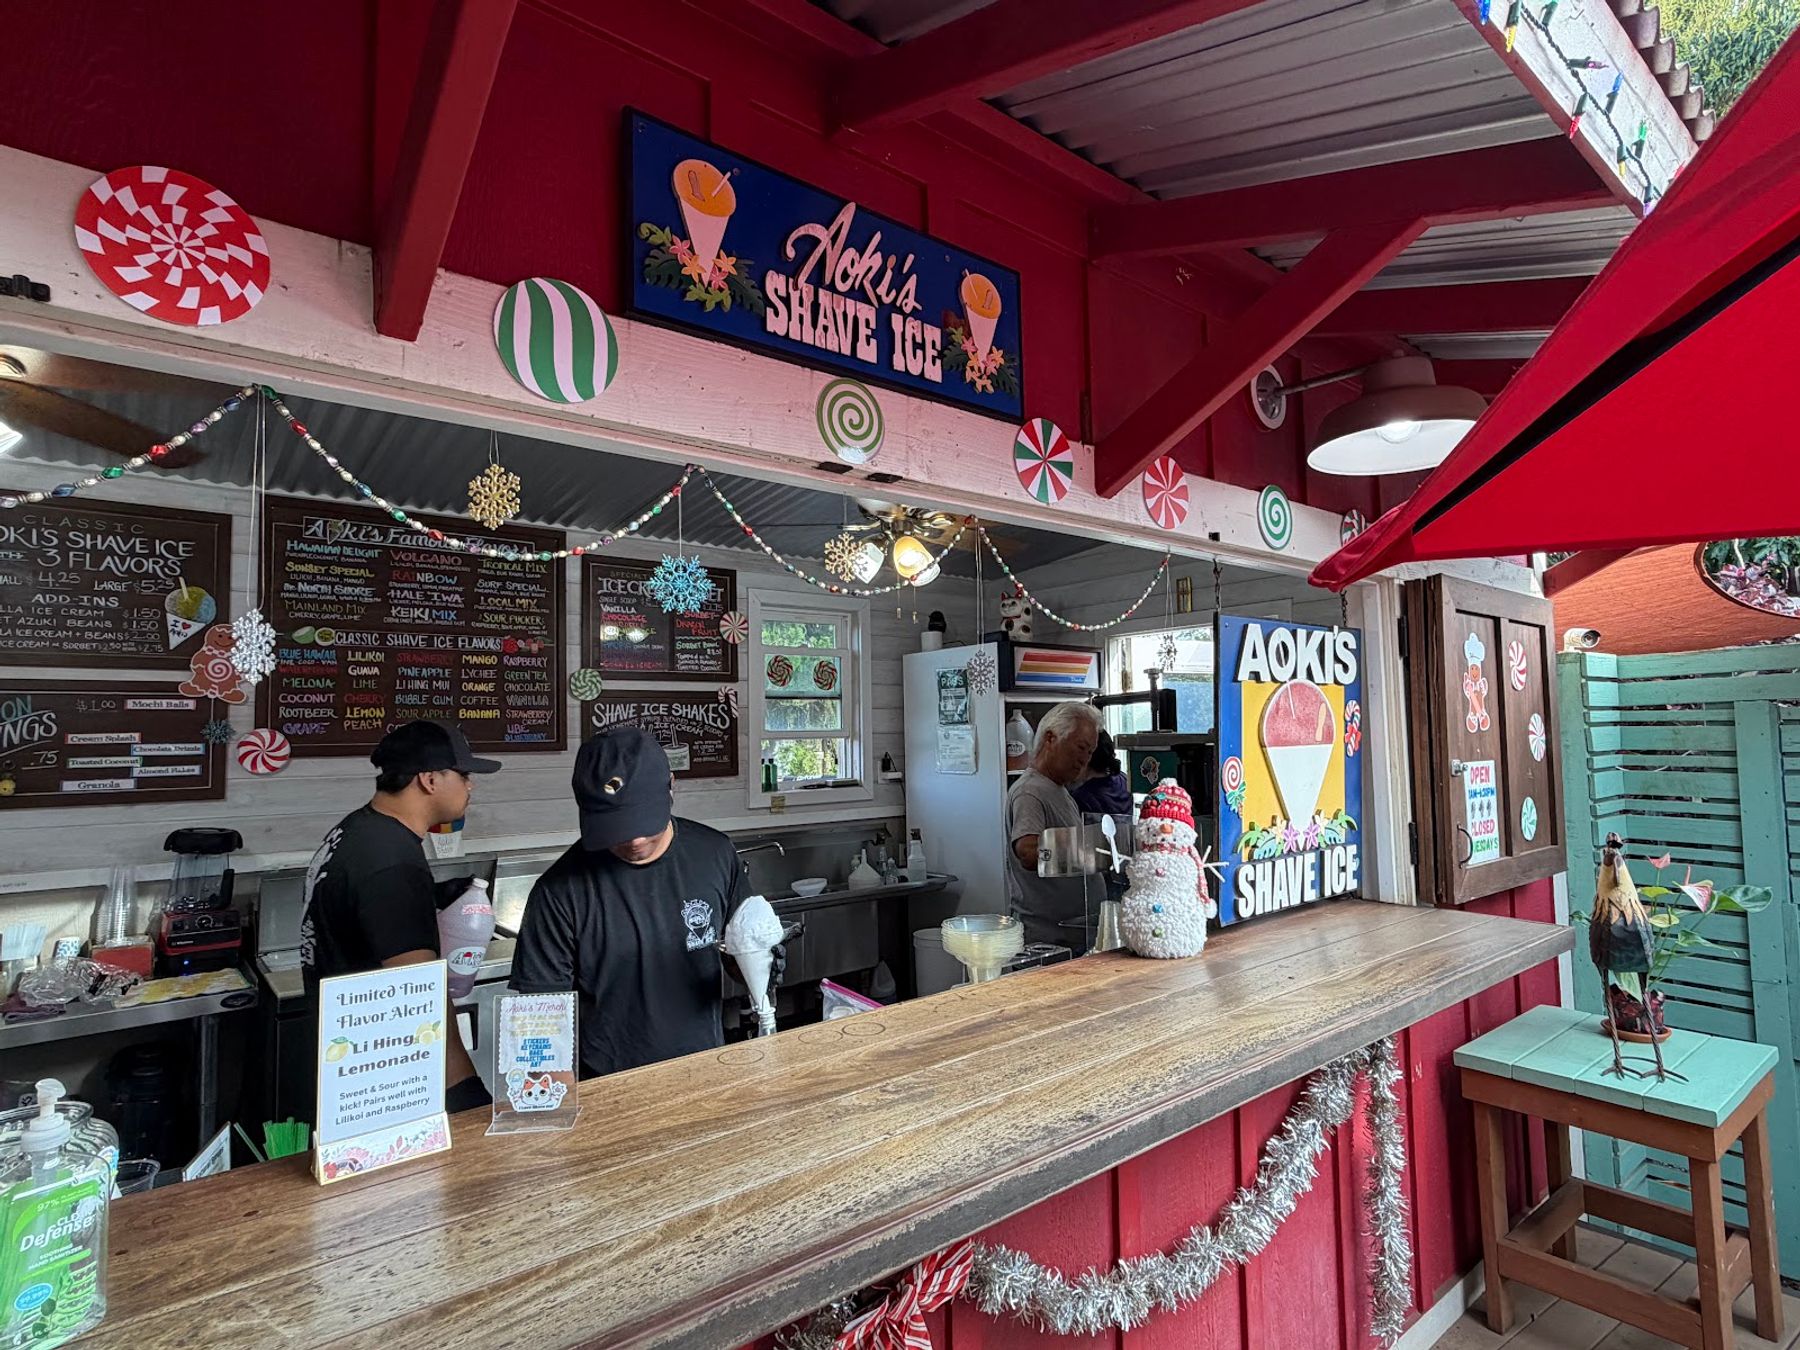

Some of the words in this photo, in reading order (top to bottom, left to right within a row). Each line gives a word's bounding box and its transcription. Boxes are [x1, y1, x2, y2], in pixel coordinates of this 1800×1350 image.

[785, 202, 923, 314] Aoki's
[765, 269, 877, 365] SHAVE
[892, 314, 942, 384] ICE
[23, 515, 145, 535] CLASSIC
[66, 531, 149, 556] SHAVE
[156, 540, 196, 559] ICE
[37, 548, 61, 567] 3
[69, 551, 182, 579] FLAVORS
[390, 549, 463, 566] VOLCANO
[329, 565, 375, 578] SPECIAL
[392, 569, 458, 584] RAINBOW
[94, 580, 131, 593] LARGE
[506, 581, 547, 592] SPECIAL
[31, 593, 119, 607] ADD-INS
[480, 596, 514, 607] LOCAL
[515, 598, 537, 608] MIX
[32, 607, 53, 616] ICE
[61, 608, 104, 617] CREAM
[285, 599, 343, 613] MAINLAND
[346, 603, 367, 615] MIX
[600, 603, 637, 614] VANILLA
[431, 609, 457, 620] MIX
[482, 612, 508, 624] SOUR
[17, 617, 57, 626] AZUKI
[67, 619, 113, 628] BEANS
[16, 629, 32, 637] ICE
[34, 630, 72, 639] CREAM
[85, 632, 123, 641] BEANS
[335, 631, 380, 645] CLASSIC
[386, 634, 431, 647] SHAVE
[434, 636, 455, 648] ICE
[458, 637, 501, 651] FLAVORS
[63, 642, 98, 650] SORBET
[347, 650, 385, 663] LILIKOI
[462, 654, 498, 665] MANGO
[1237, 622, 1357, 687] AOKI'S
[503, 655, 548, 668] RASPBERRY
[398, 666, 453, 678] PINEAPPLE
[461, 668, 498, 679] LYCHEE
[504, 670, 531, 681] GREEN
[532, 671, 548, 681] TEA
[282, 677, 336, 689] MELONA
[353, 679, 378, 689] LIME
[396, 679, 405, 690] LI
[407, 679, 429, 690] HING
[462, 682, 496, 692] ORANGE
[504, 682, 551, 692] CHOCOLATE
[279, 693, 336, 704] COCONUT
[395, 694, 430, 705] BUBBLE
[432, 695, 453, 706] GUM
[460, 696, 499, 706] COFFEE
[1, 695, 32, 721] ON
[131, 701, 164, 709] Mochi
[345, 706, 385, 719] LEMON
[396, 708, 419, 719] SOUR
[422, 708, 452, 719] APPLE
[459, 708, 500, 719] BANANA
[505, 709, 553, 721] STRAWBERRY
[591, 702, 638, 727] SHAVE
[641, 703, 669, 716] ICE
[672, 702, 730, 730] SHAKES
[343, 719, 382, 731] PEACH
[522, 718, 549, 726] CREAM
[0, 712, 58, 748] NGS
[283, 722, 330, 735] GRAPE
[508, 723, 530, 734] UBE
[675, 723, 704, 737] CREAM
[71, 735, 104, 743] Cream
[105, 735, 141, 743] Splash
[71, 758, 103, 766] Toasted
[1470, 765, 1490, 785] OPEN
[78, 781, 121, 789] Granola
[1238, 852, 1318, 919] SHAVE
[1324, 844, 1359, 899] ICE
[336, 984, 396, 1006] Limited
[399, 981, 435, 995] Time
[336, 1011, 387, 1029] Flavor
[389, 1000, 433, 1021] Alert!
[353, 1040, 368, 1054] Li
[373, 1034, 414, 1050] Hing
[338, 1049, 430, 1077] Lemonade
[339, 1087, 368, 1100] Sweet
[369, 1085, 376, 1093] &
[378, 1080, 400, 1091] Sour
[401, 1075, 420, 1086] with
[339, 1101, 361, 1112] kick!
[363, 1096, 386, 1107] Pairs
[388, 1090, 406, 1101] well
[408, 1085, 427, 1096] with
[336, 1112, 364, 1126] Lilikoi
[365, 1106, 383, 1117] and
[385, 1097, 430, 1113] Raspberry
[37, 1200, 59, 1212] 97%
[20, 1214, 95, 1252] Defense
